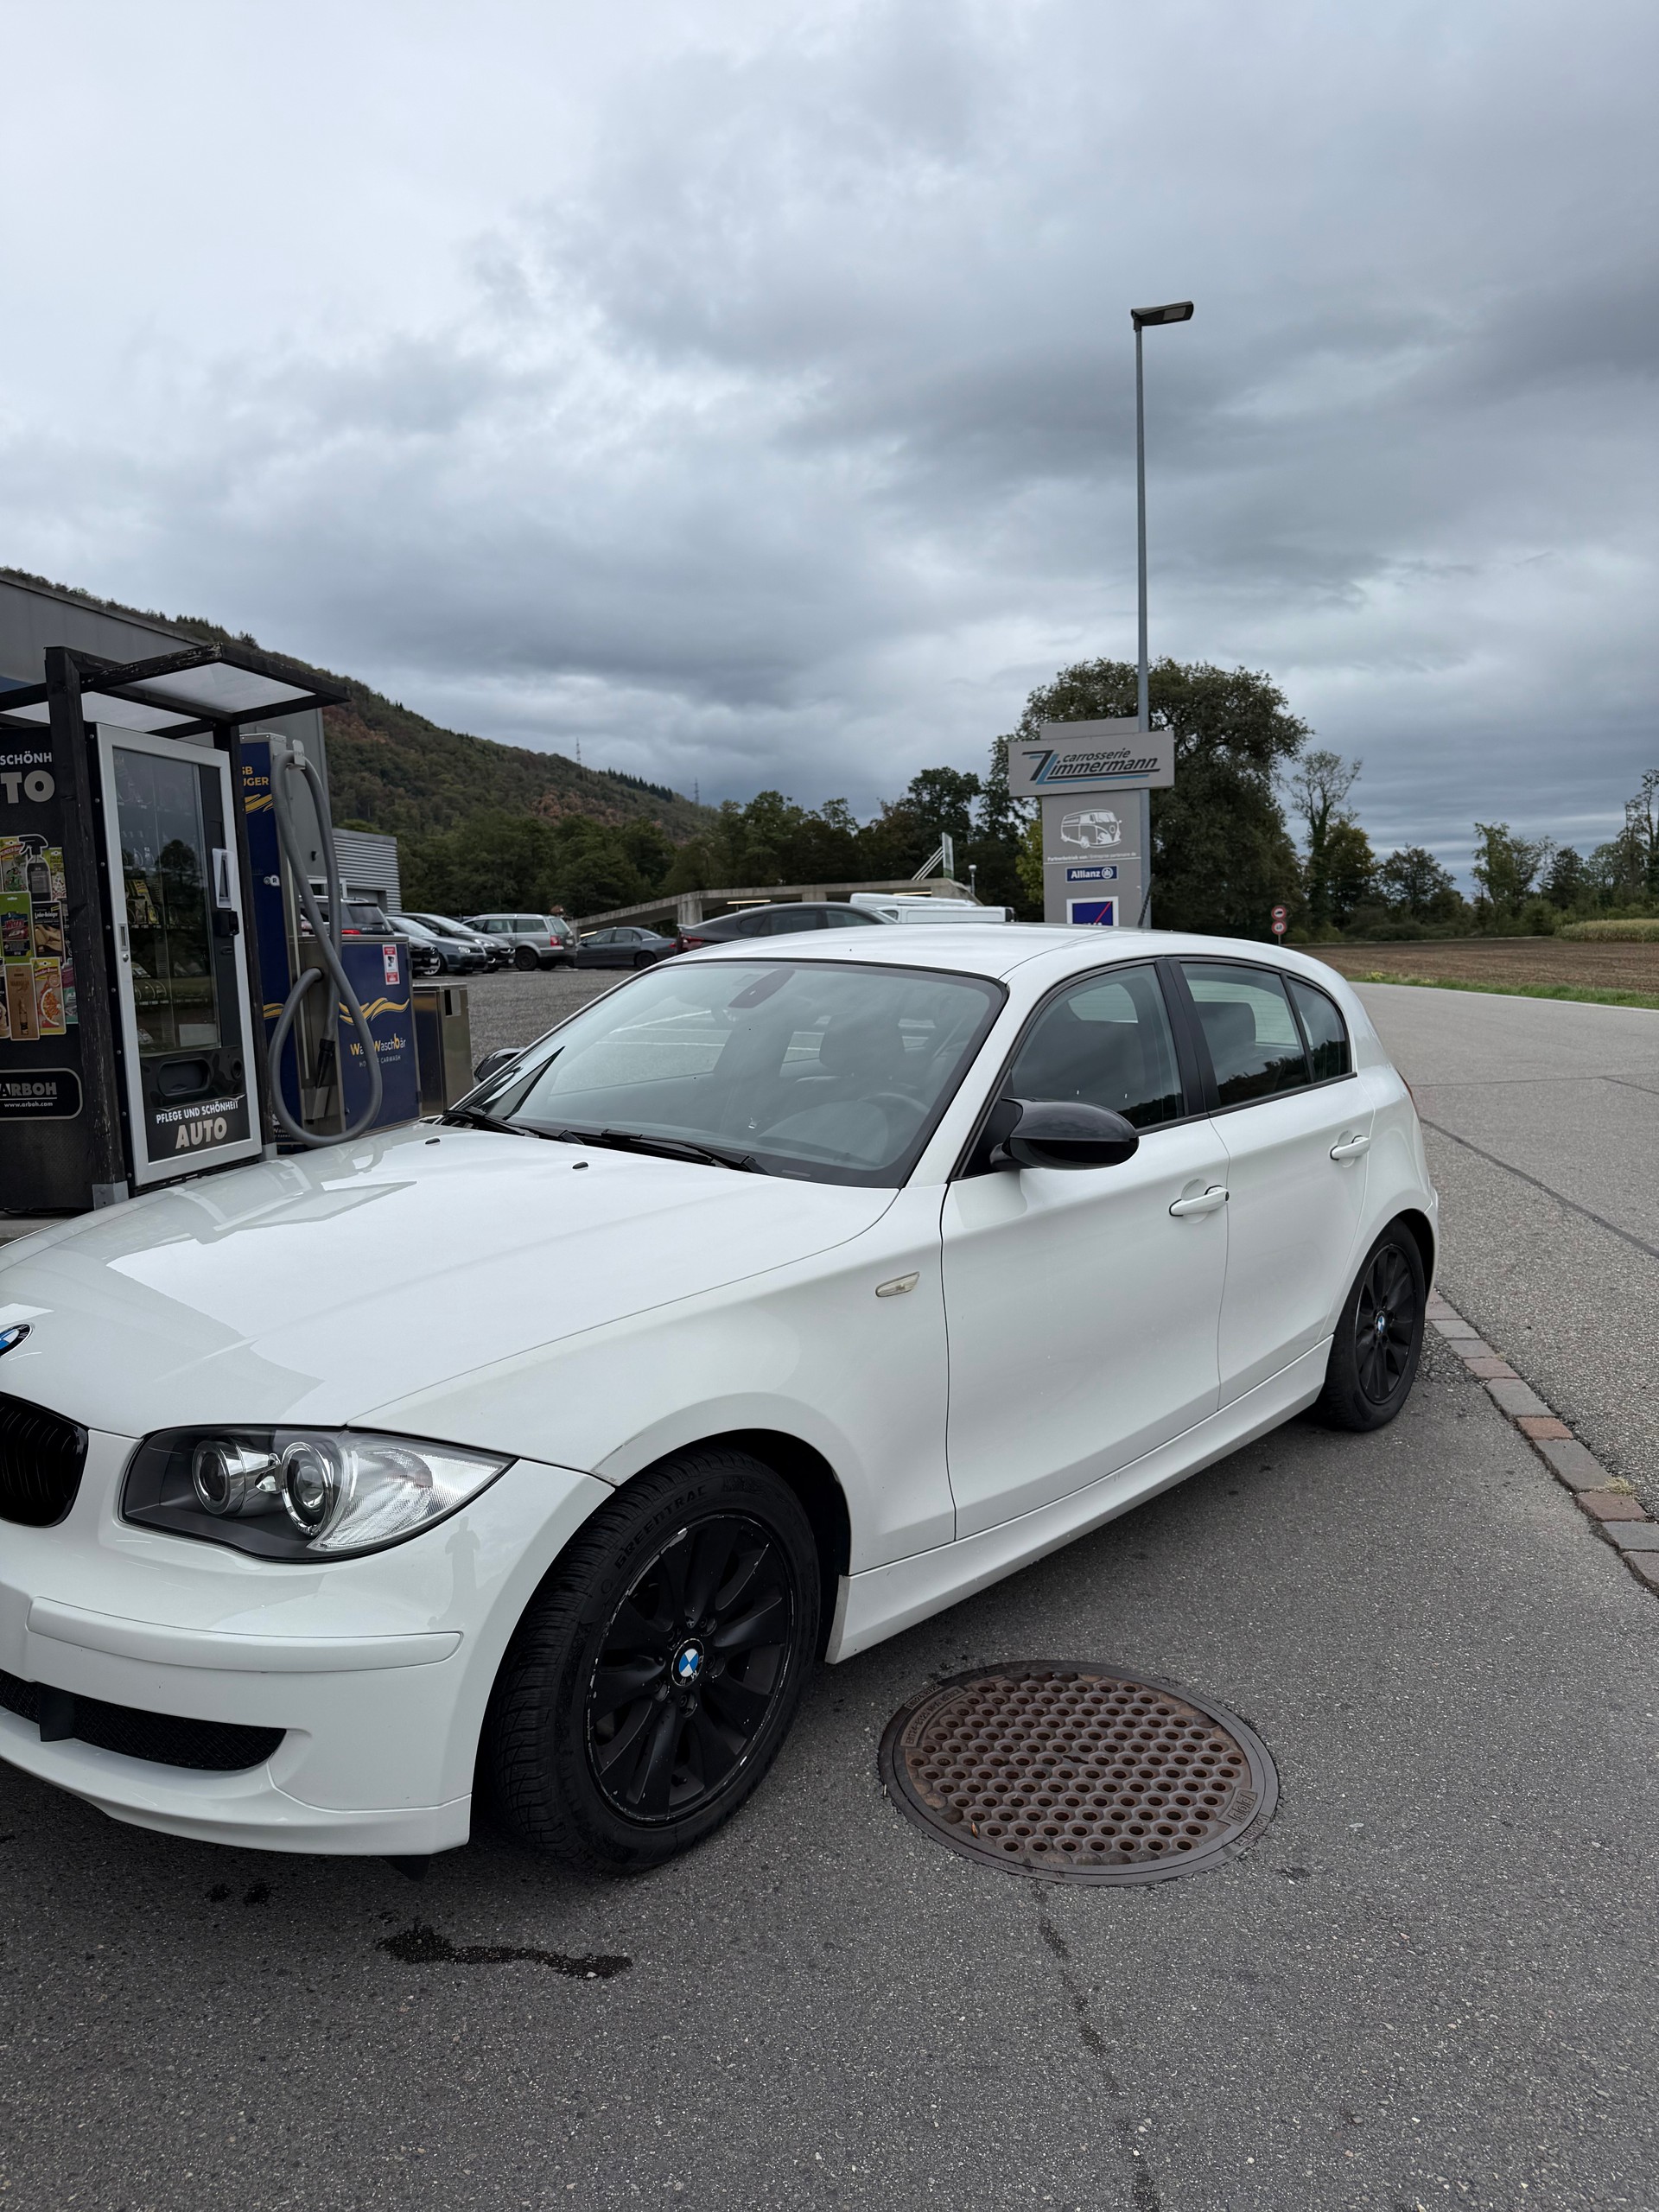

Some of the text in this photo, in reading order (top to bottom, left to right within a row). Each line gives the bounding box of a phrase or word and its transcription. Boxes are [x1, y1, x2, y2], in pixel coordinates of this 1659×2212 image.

[0, 751, 52, 766] SCHÖNH
[1021, 749, 1160, 785] Zimmermann
[1063, 747, 1131, 763] carrosserie
[0, 770, 55, 804] TO
[1071, 870, 1101, 880] Allianz
[156, 1100, 238, 1124] PFLEGE UND SCHÖNHEIT
[175, 1116, 227, 1149] AUTO
[614, 1486, 707, 1569] GREENTRAC
